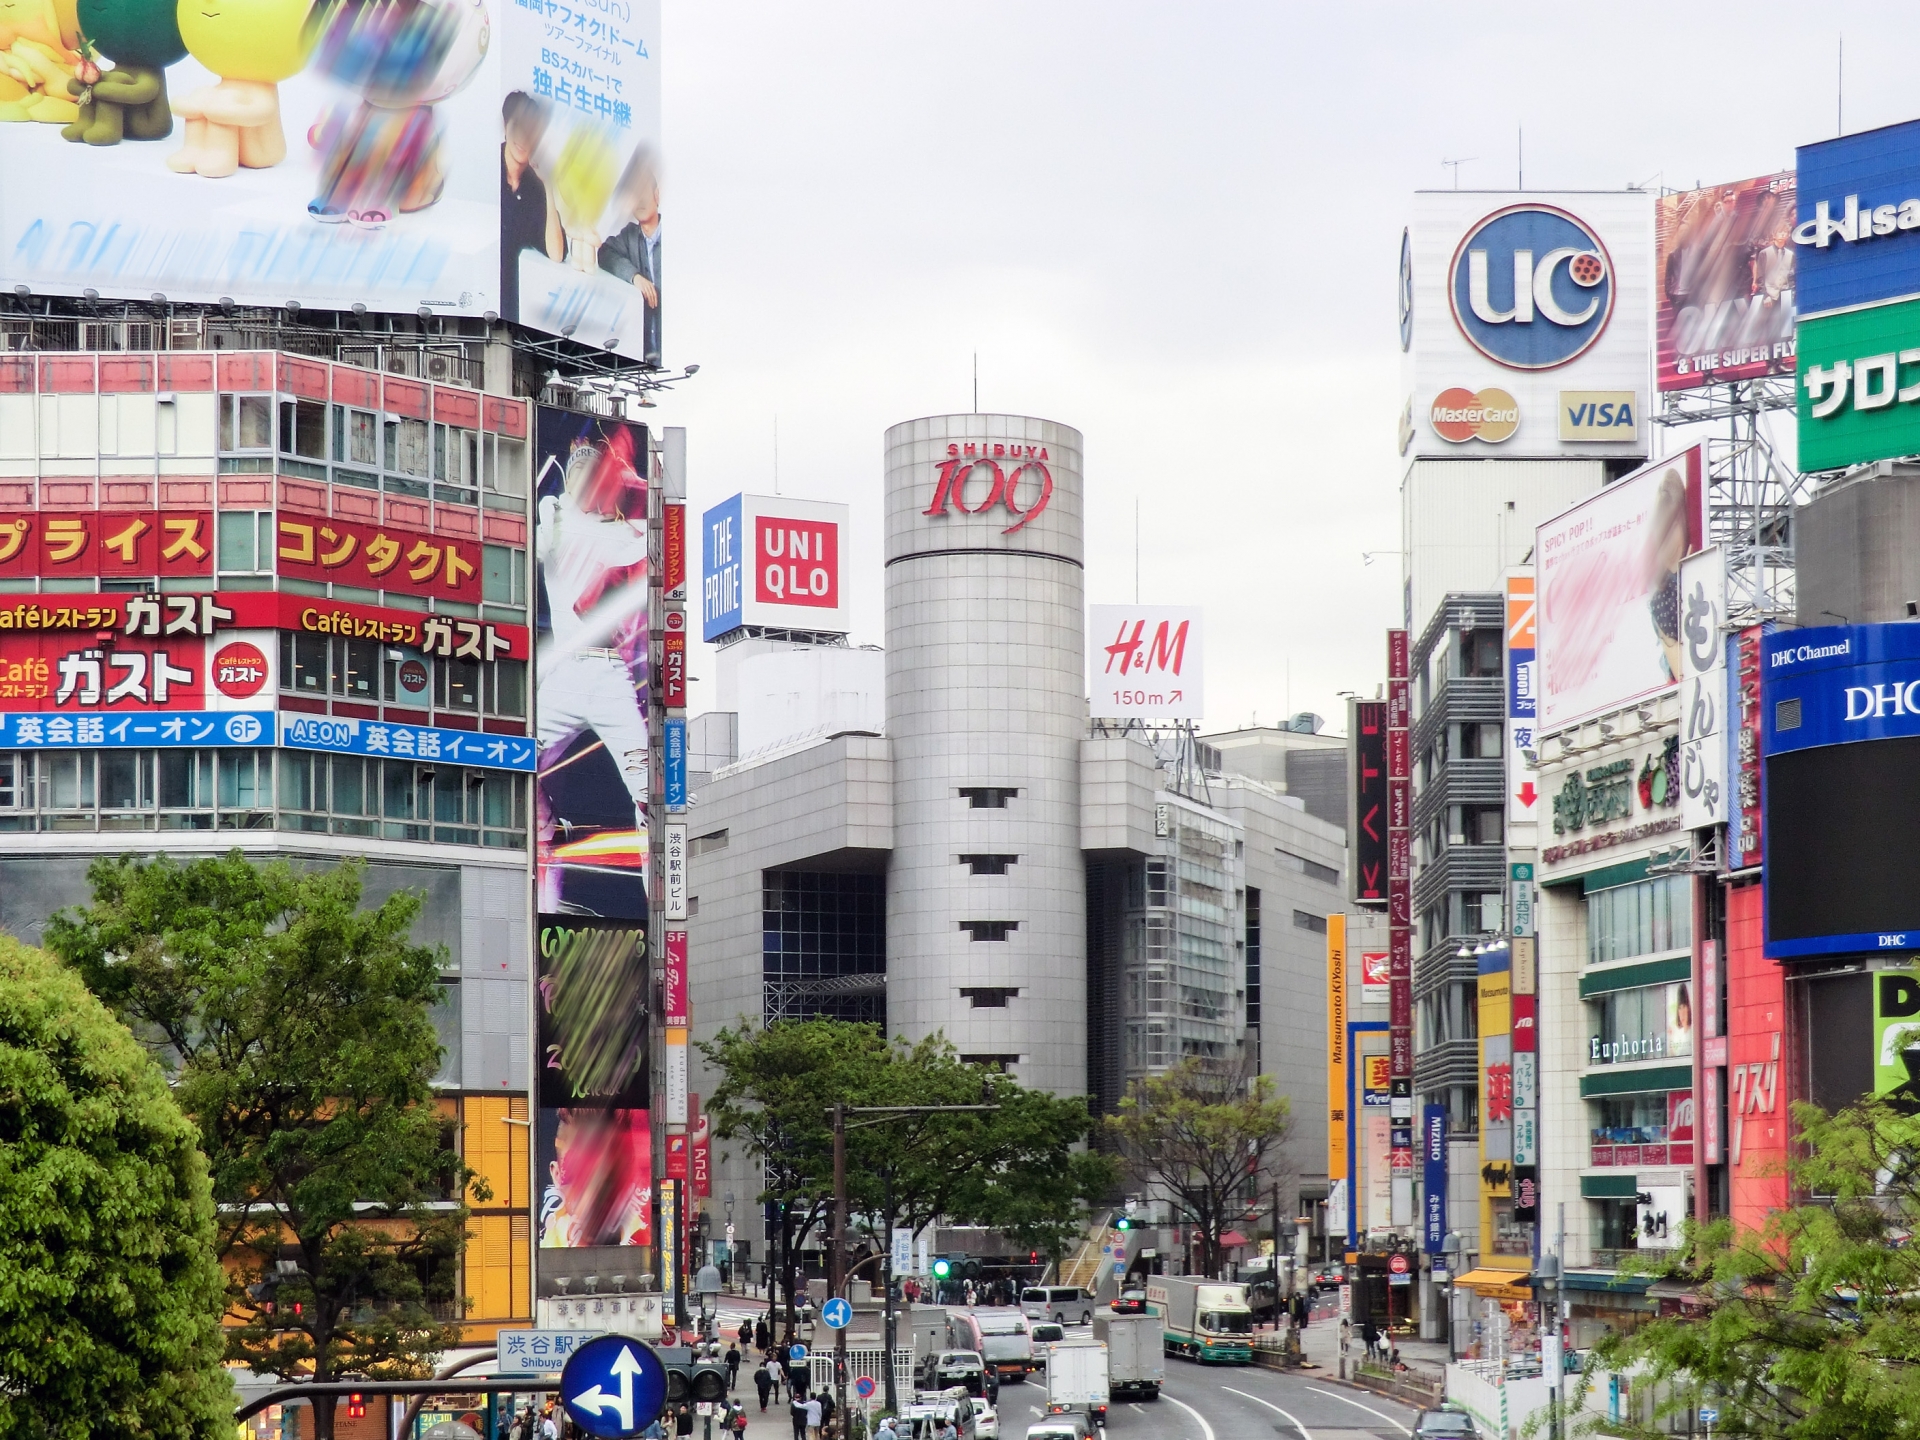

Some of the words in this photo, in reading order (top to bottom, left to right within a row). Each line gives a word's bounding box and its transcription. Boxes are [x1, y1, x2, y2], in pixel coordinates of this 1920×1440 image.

[544, 22, 622, 66] ツアーファイナル
[1693, 350, 1719, 371] THE
[1722, 343, 1769, 367] SUPER
[1432, 406, 1518, 424] MasterCard
[1567, 403, 1634, 427] VISA
[947, 442, 1049, 461] SHIBUYA
[922, 458, 1053, 534] 109
[0, 518, 206, 561] プライス
[712, 516, 733, 569] THE
[765, 527, 823, 562] UNI
[1544, 530, 1566, 553] SPICY
[1569, 517, 1593, 540] POP!!
[279, 521, 474, 585] コンタクト
[668, 543, 680, 585] コンタクト
[672, 590, 684, 598] 8F
[705, 563, 739, 623] PRIME
[765, 564, 829, 599] QLO
[126, 594, 232, 635] ガスト
[421, 617, 511, 662] ガスト
[1104, 619, 1190, 676] H&M
[1771, 649, 1796, 668] DHC
[1797, 639, 1850, 662] Channel
[55, 650, 193, 705] ガスト
[219, 667, 263, 683] ガスト
[402, 673, 426, 684] ガスト
[668, 652, 682, 697] ガスト
[1684, 581, 1718, 817] もんじゃ
[16, 717, 215, 744] 英会話イーオン
[229, 721, 258, 736] 6F
[291, 720, 351, 746] AEON
[366, 725, 532, 764] 英会話イーオン
[669, 727, 682, 803] 英会話イーオン
[669, 832, 682, 911] 渋谷駅前ビル
[666, 932, 686, 943] 5F
[1878, 934, 1906, 948] DHC
[1332, 949, 1342, 994] KiYoshi
[1332, 1011, 1342, 1064] Matsumoto
[1591, 1031, 1663, 1063] Euphoria
[1516, 1068, 1524, 1095] パーラー
[1524, 1063, 1532, 1091] フルーツ
[1331, 1109, 1345, 1122] 薬
[1671, 1098, 1693, 1132] JTB
[1431, 1116, 1441, 1161] MIZUHO
[1516, 1124, 1524, 1153] フルーツ
[695, 1148, 707, 1181] アコム
[1429, 1194, 1441, 1242] みずほ銀行
[900, 1232, 910, 1272] 渋谷駅前
[521, 1357, 562, 1370] Shibuya
